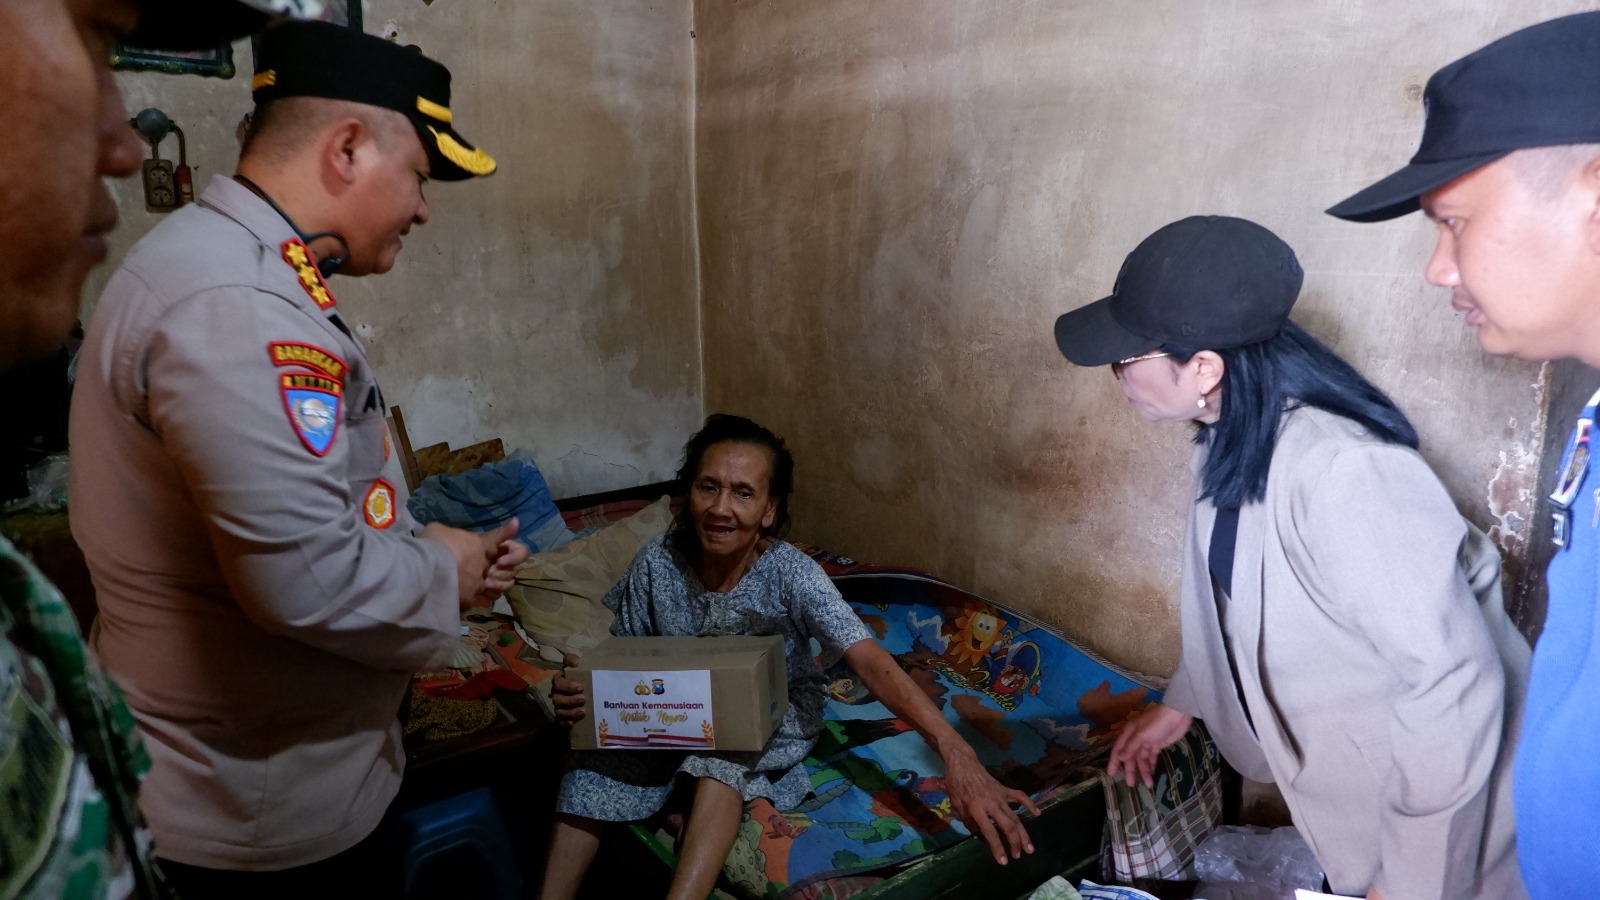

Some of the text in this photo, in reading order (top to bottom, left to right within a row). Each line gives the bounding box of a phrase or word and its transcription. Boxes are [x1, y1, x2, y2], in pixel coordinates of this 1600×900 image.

[603, 701, 704, 710] Bantuan Kemanusiaan
[619, 710, 689, 727] Untuk Negeri
